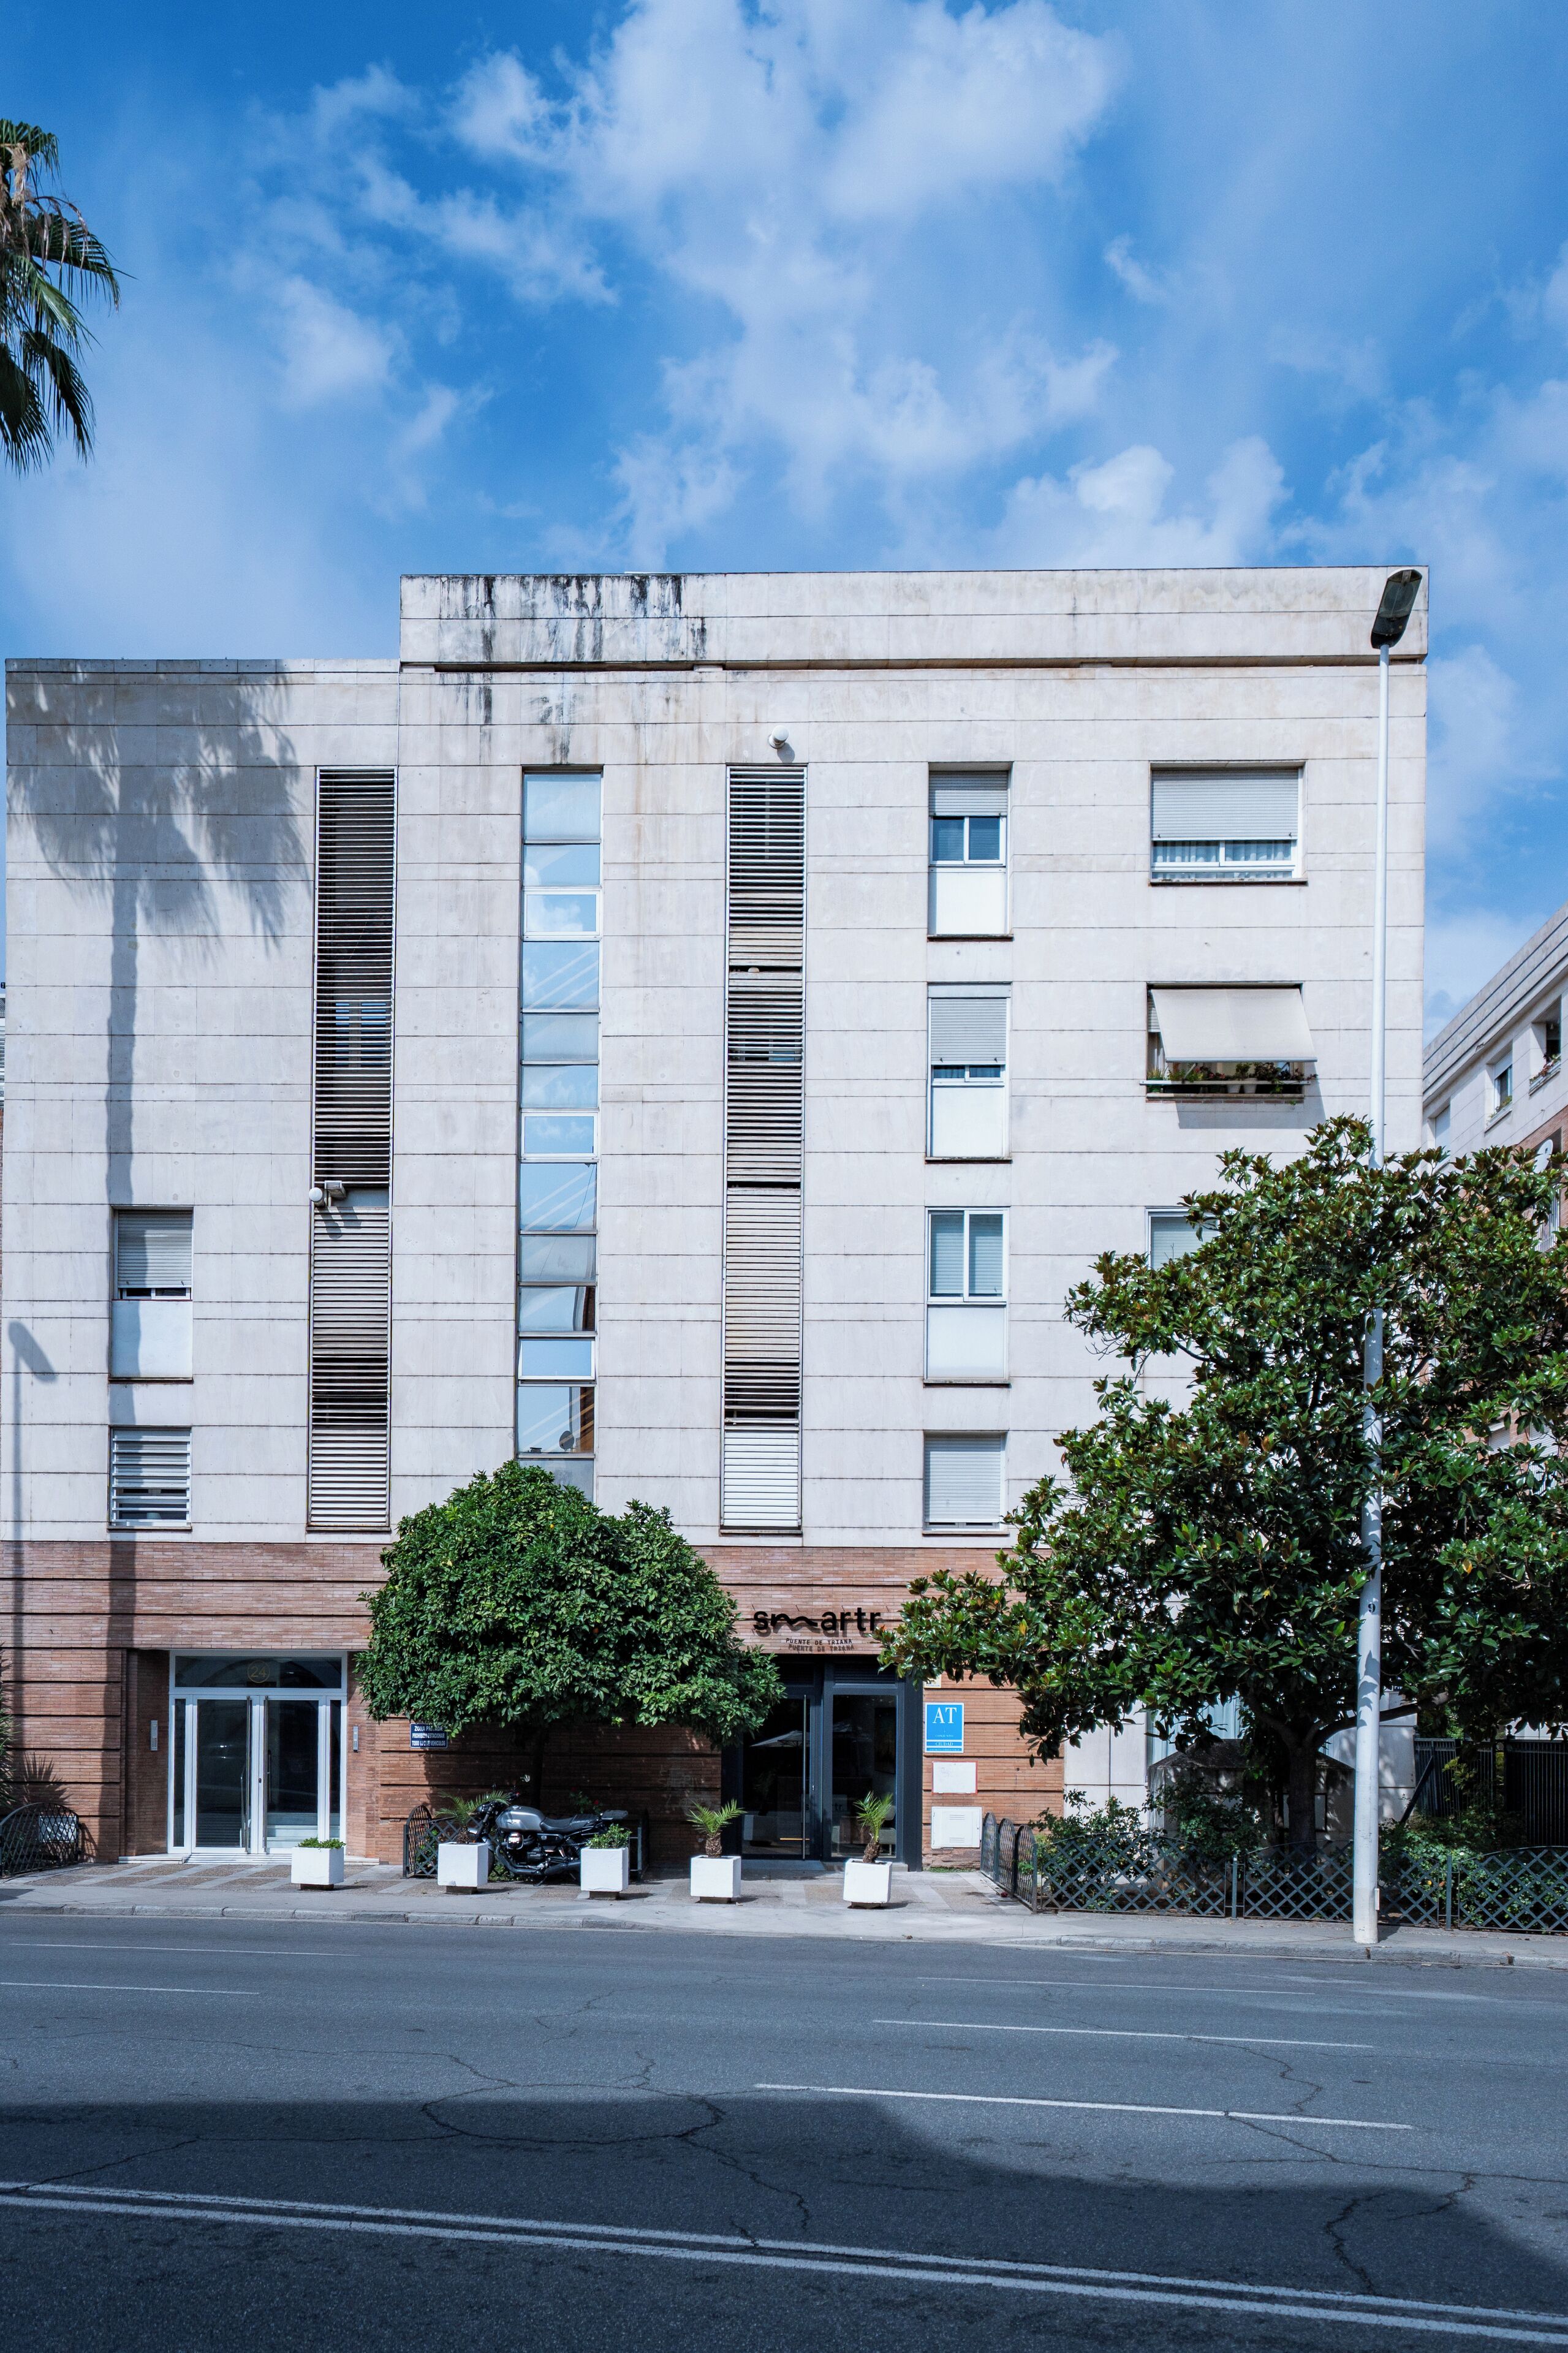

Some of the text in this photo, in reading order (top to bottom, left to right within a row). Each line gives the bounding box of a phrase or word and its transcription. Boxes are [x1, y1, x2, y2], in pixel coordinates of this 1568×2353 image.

[1368, 1603, 1376, 1613] 9
[753, 1607, 881, 1631] smartr
[250, 1665, 267, 1678] 24
[932, 1707, 957, 1724] AT
